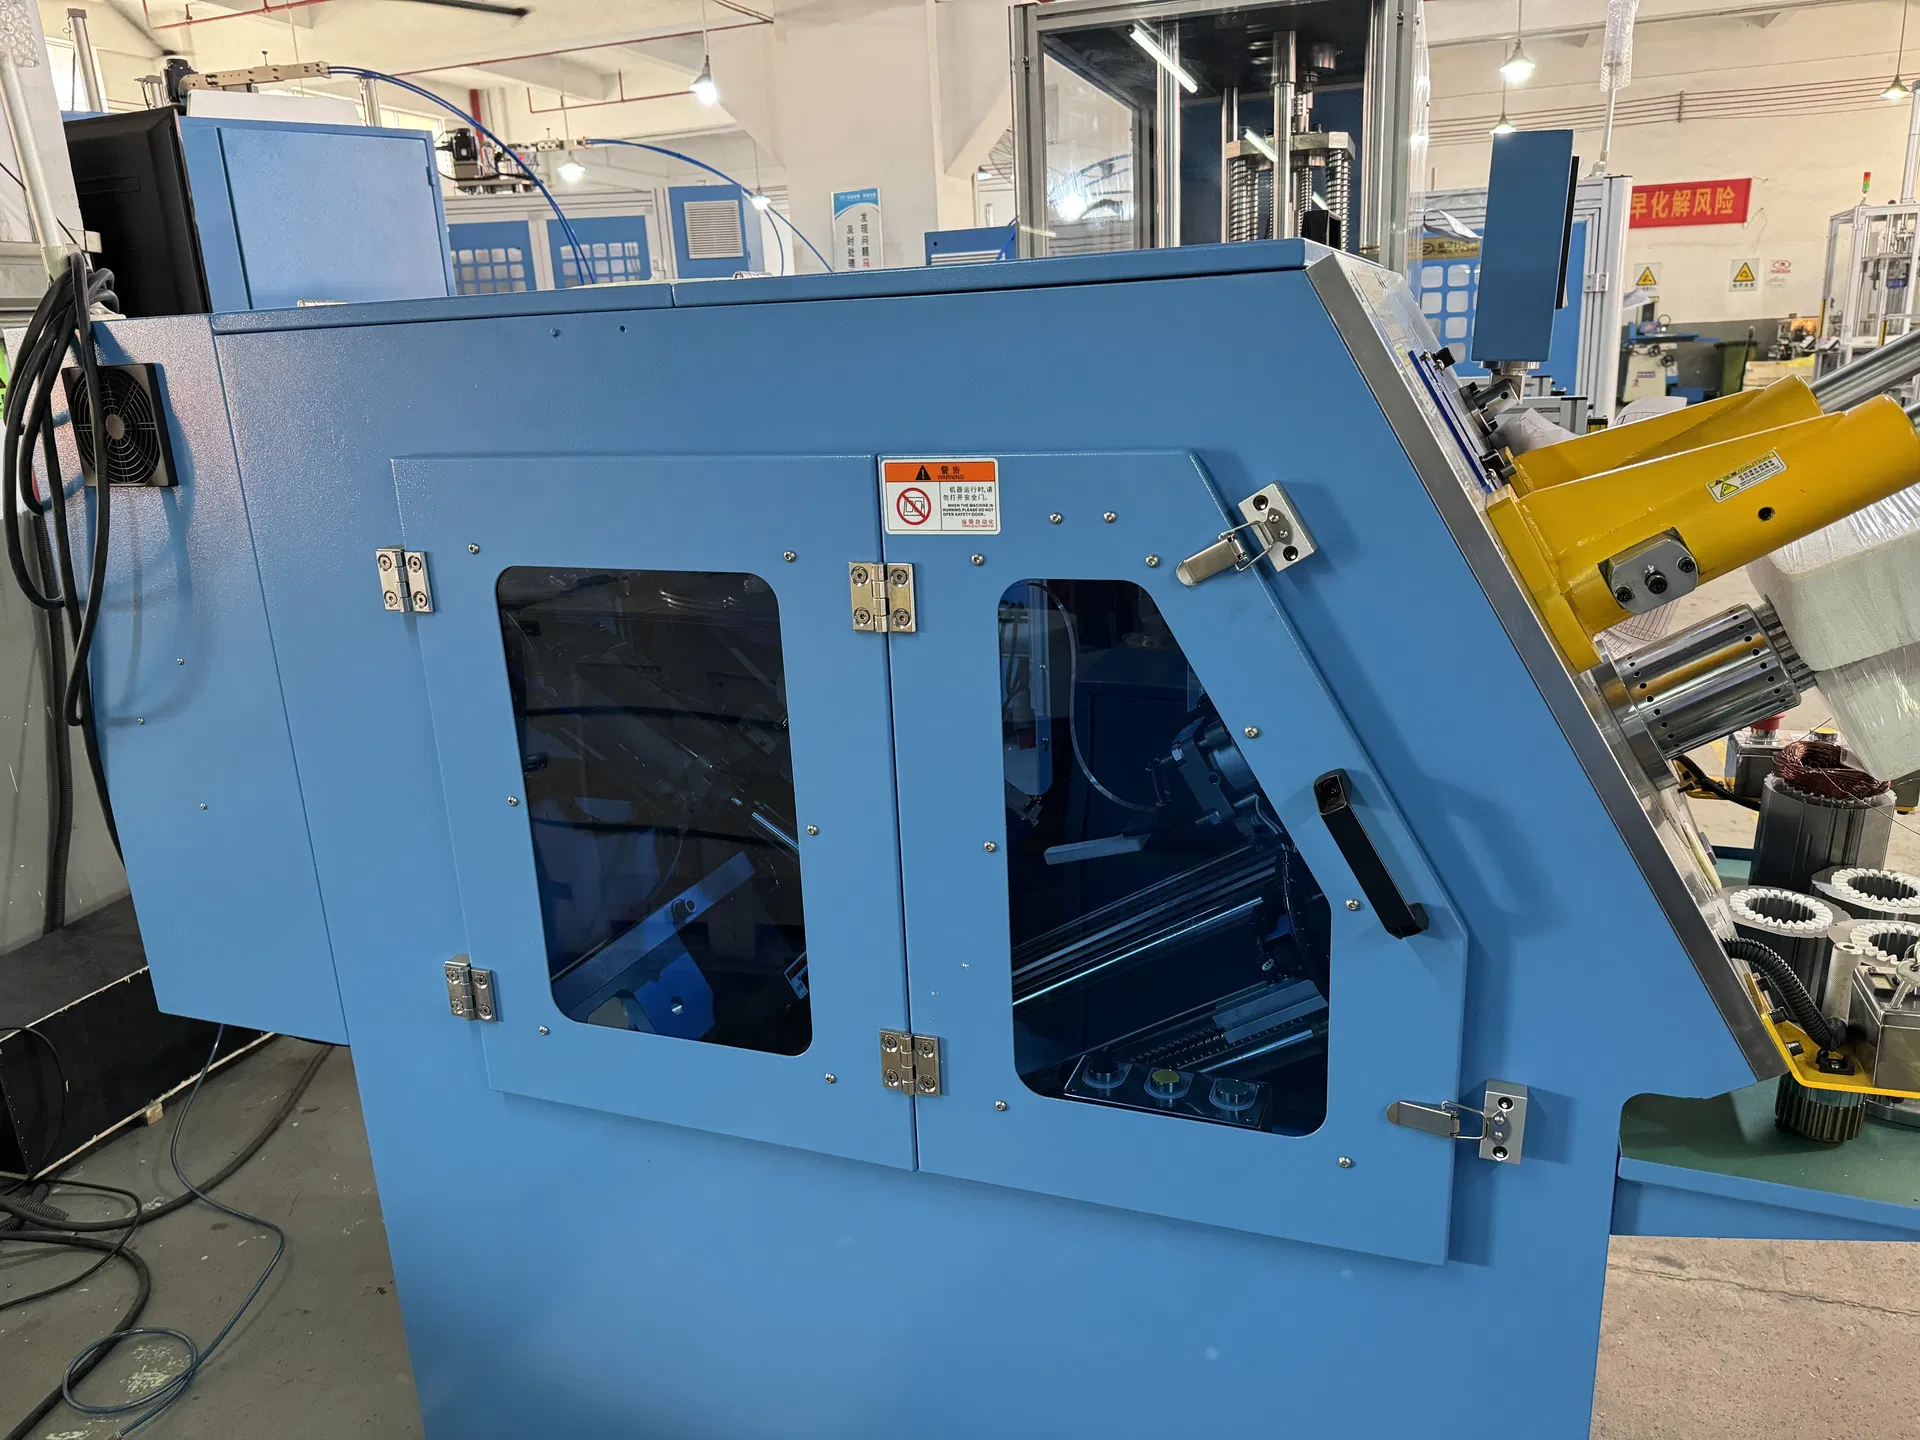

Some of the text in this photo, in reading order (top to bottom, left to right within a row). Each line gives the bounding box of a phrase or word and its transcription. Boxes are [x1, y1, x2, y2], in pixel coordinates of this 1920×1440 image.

[1631, 185, 1735, 219] 早化解风险
[940, 465, 960, 474] 警告
